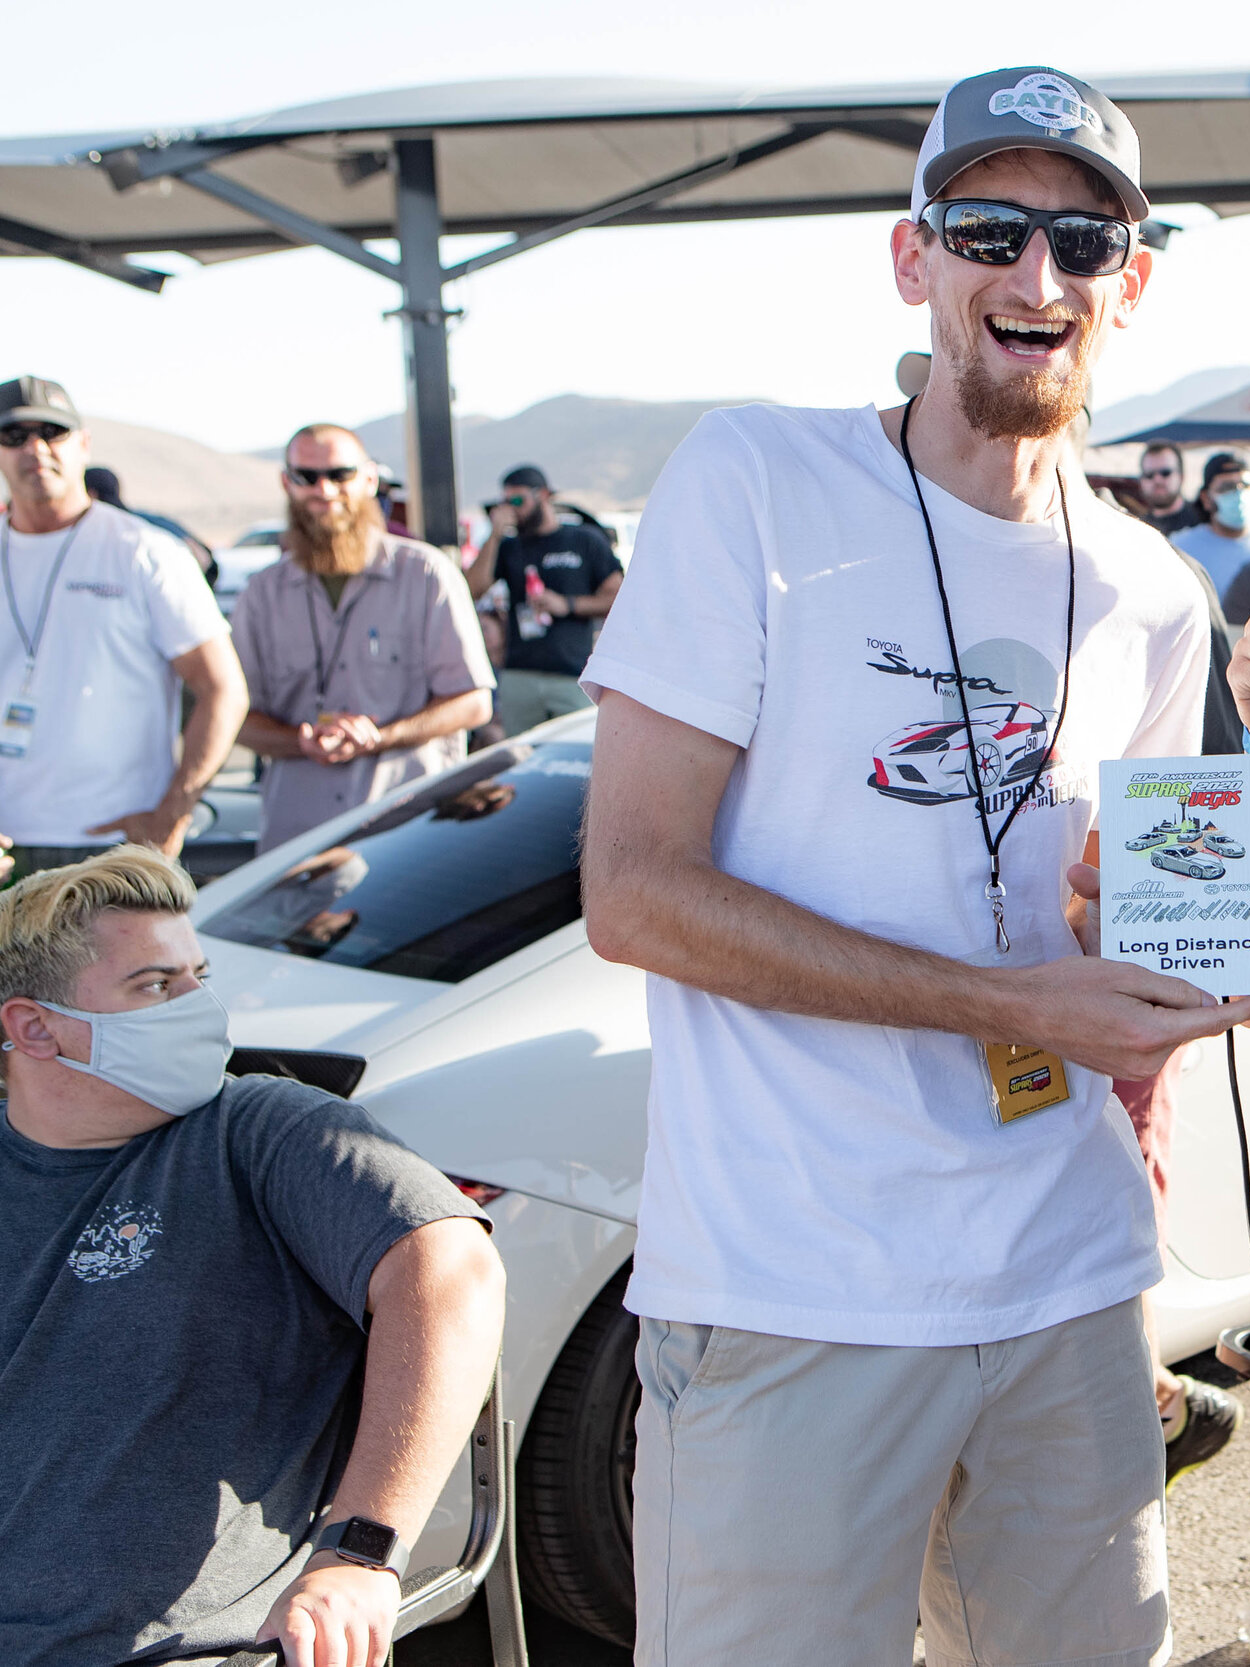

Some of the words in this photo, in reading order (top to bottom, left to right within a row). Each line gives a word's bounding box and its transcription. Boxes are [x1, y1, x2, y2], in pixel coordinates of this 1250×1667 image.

[1023, 75, 1046, 87] AUTO
[1050, 77, 1077, 97] GROUP
[994, 92, 1098, 129] BAYER
[866, 638, 903, 654] TOYOTA
[866, 652, 1013, 695] Supra
[939, 688, 957, 699] MKV
[1027, 735, 1038, 751] 90
[1160, 771, 1242, 780] ANNIVERSARY
[1125, 781, 1192, 798] SUPRAS
[1193, 780, 1243, 791] 2020
[1188, 790, 1242, 810] VEGAS
[1112, 890, 1184, 900] driftmotion.com
[1119, 941, 1169, 955] Long
[1160, 956, 1225, 970] Driven
